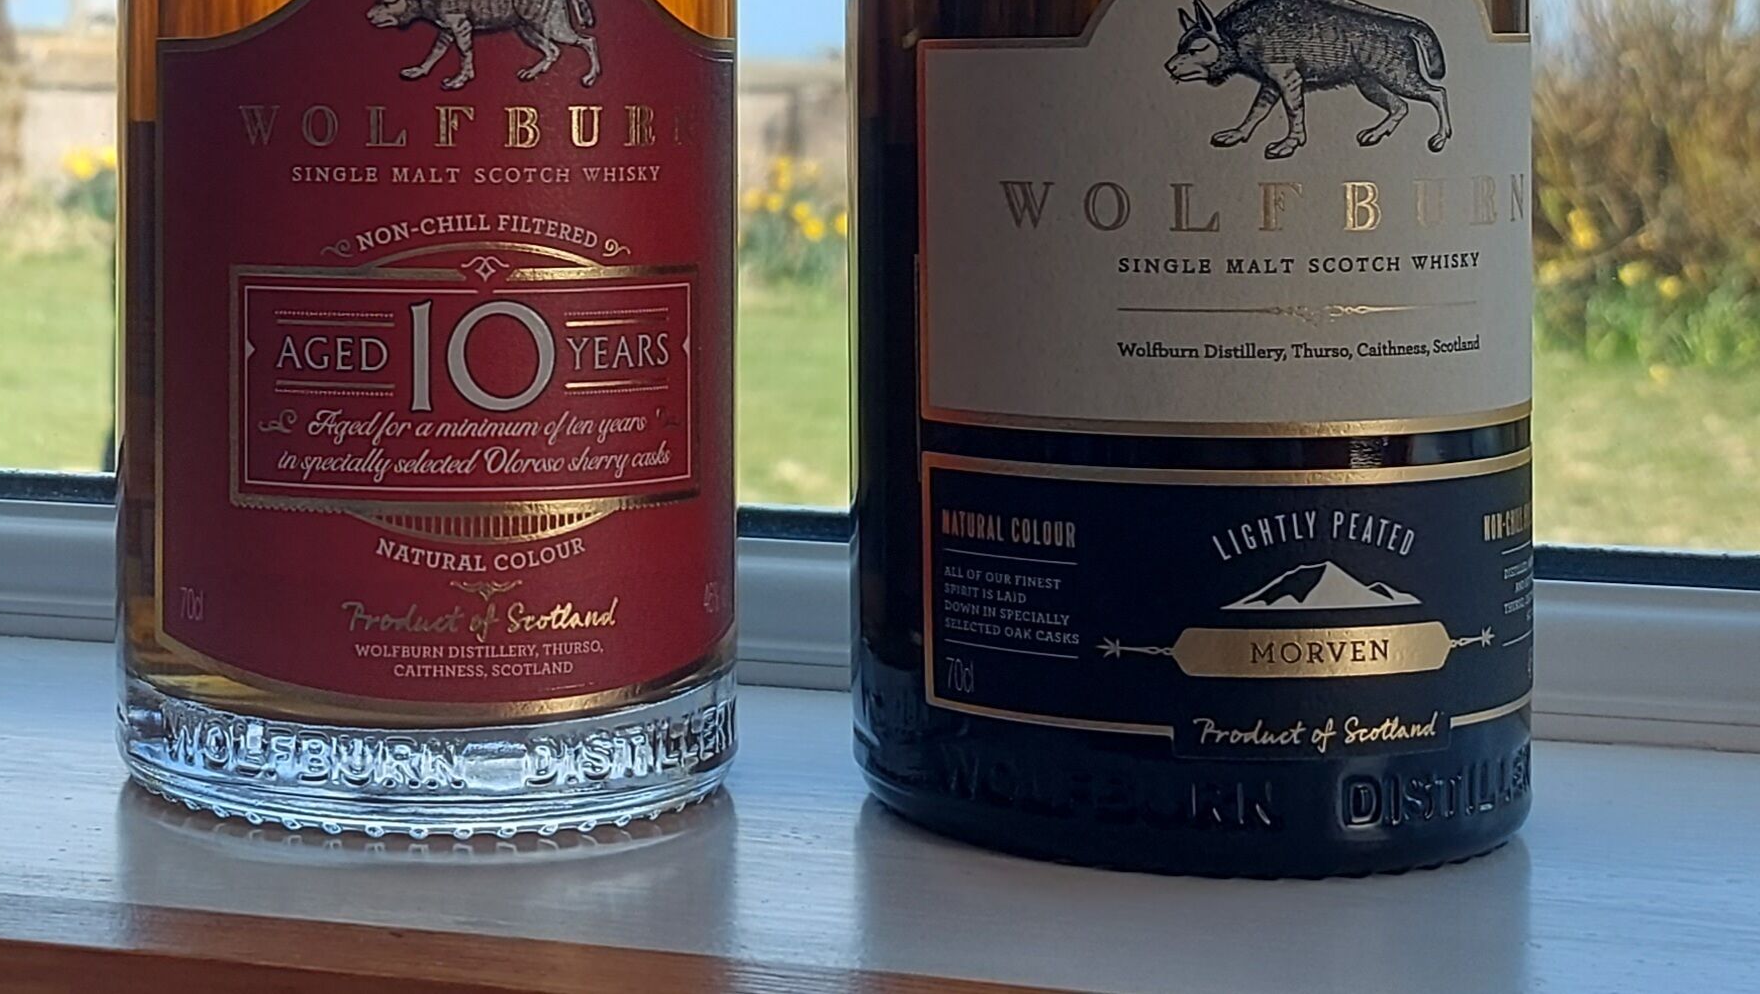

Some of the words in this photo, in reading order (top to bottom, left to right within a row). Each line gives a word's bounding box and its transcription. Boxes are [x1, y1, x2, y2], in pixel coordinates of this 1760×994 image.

[291, 166, 379, 183] SINGLE
[392, 166, 461, 184] MALT
[474, 166, 571, 184] SCOTCH
[581, 164, 662, 182] WHISKY
[998, 173, 1526, 233] WOLFBURN
[355, 214, 492, 252] NON-CHILL
[497, 214, 599, 249] FILTERED
[1117, 256, 1213, 274] SINGLE
[1225, 256, 1295, 275] MALT
[1307, 254, 1402, 274] SCOTCH
[1411, 251, 1481, 271] WHISKY
[275, 335, 390, 372] AGED
[408, 299, 557, 412] 10
[566, 331, 670, 371] YEARS
[1117, 341, 1200, 360] Wolfburn
[1203, 341, 1288, 363] Distillery,
[1290, 343, 1353, 361] Thurso,
[1356, 338, 1431, 358] Caithness,
[1432, 334, 1480, 354] Scotland
[307, 409, 382, 445] Aged
[372, 411, 411, 446] for
[415, 421, 434, 437] a
[435, 418, 538, 438] minimum
[543, 410, 570, 446] of
[566, 416, 594, 435] ten
[596, 415, 647, 444] years
[278, 449, 298, 470] in
[300, 447, 391, 483] specially
[393, 448, 482, 474] selected
[483, 446, 565, 474] Oloroso
[567, 446, 630, 479] sherry
[631, 440, 671, 468] casks
[941, 508, 1005, 542] NATURAL
[1010, 517, 1077, 549] COLOUR
[1211, 510, 1317, 561] LIGHTLY
[1332, 510, 1416, 557] PEATED
[375, 536, 487, 572] NATURAL
[493, 536, 586, 571] COLOUR
[944, 565, 964, 579] ALL
[966, 568, 982, 581] OF
[985, 571, 1012, 586] OUR
[1014, 574, 1062, 591] FINEST
[944, 582, 979, 598] SPIRIT
[982, 588, 994, 600] IS
[996, 590, 1027, 604] LAID
[179, 586, 204, 621] 70cl
[341, 600, 466, 634] Product
[468, 604, 500, 643] of
[506, 596, 619, 635] Scotland
[944, 599, 979, 615] DOWN
[982, 605, 996, 617] IN
[999, 608, 1070, 627] SPECIALLY
[944, 617, 1001, 636] SELECTED
[1004, 625, 1032, 640] OAK
[1035, 629, 1080, 645] CASKS
[354, 643, 444, 658] WOLFBURN
[447, 643, 540, 660] DISTILLERY,
[542, 639, 605, 656] THURSO,
[1249, 638, 1391, 664] MORVEN
[393, 663, 488, 680] CAITHNESS,
[491, 661, 574, 677] SCOTLAND
[945, 656, 975, 693] 70cl
[1192, 717, 1306, 745] Product
[1311, 717, 1337, 754] of
[1343, 711, 1439, 745] Scotland
